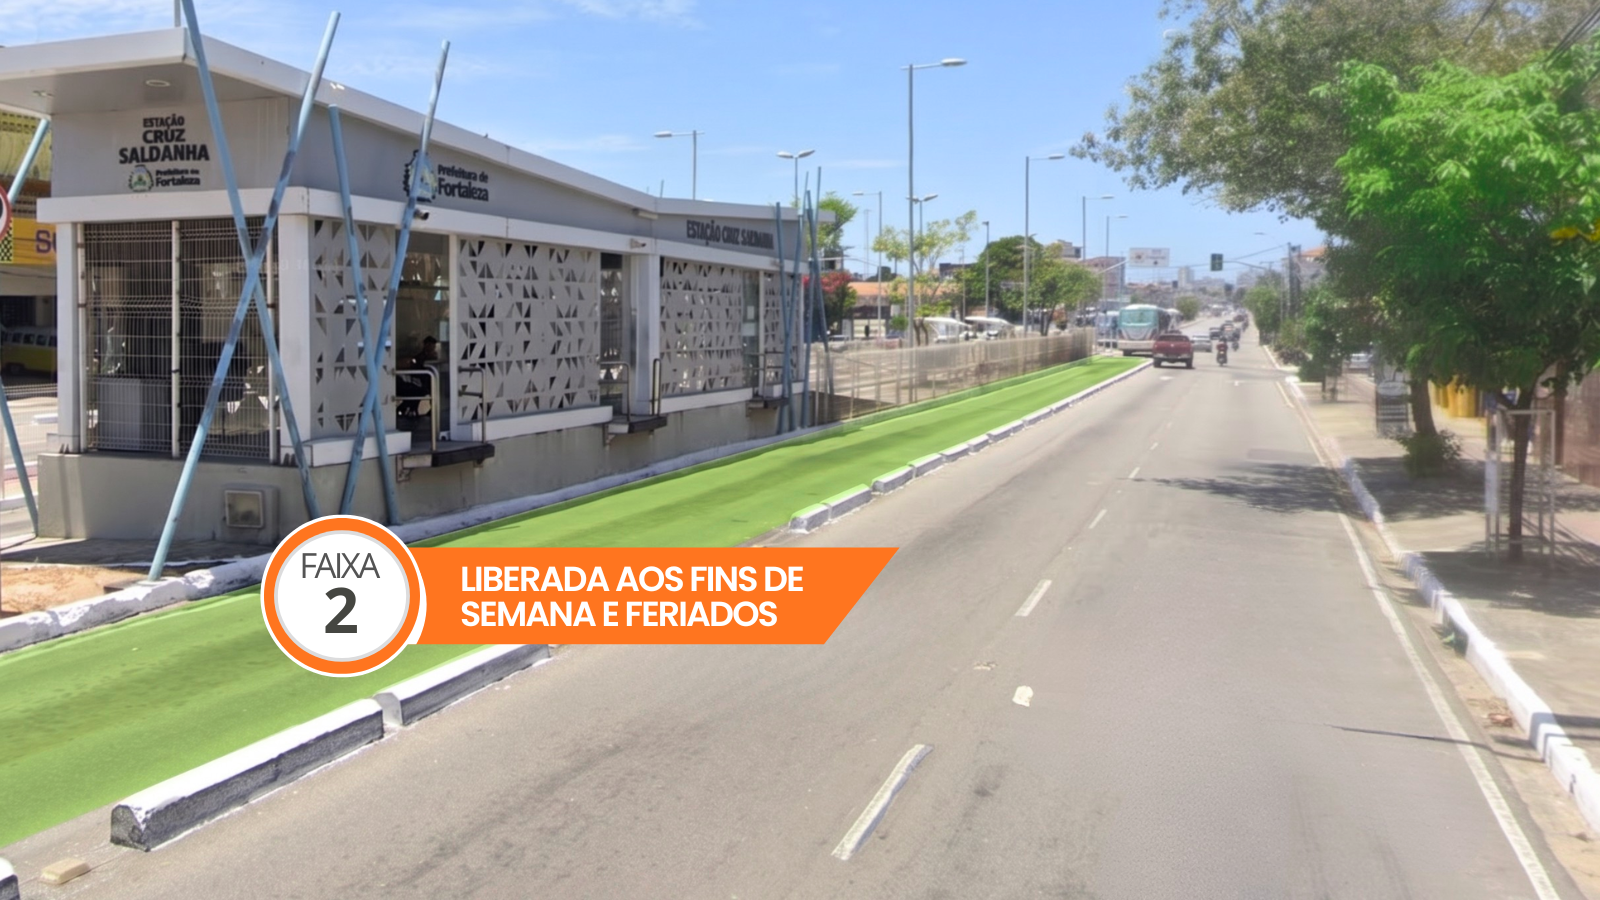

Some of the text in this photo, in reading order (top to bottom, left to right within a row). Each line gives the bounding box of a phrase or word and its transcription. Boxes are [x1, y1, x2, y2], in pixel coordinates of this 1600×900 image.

[143, 113, 185, 130] ESTAÇÃO
[142, 129, 186, 144] CRUZ
[119, 144, 210, 164] SALDANHA
[156, 176, 201, 187] Fortaleza
[437, 164, 488, 183] Prefeitura de
[438, 177, 489, 202] Fortaleza
[36, 229, 56, 254] S
[686, 219, 721, 246] ESTAÇÃO
